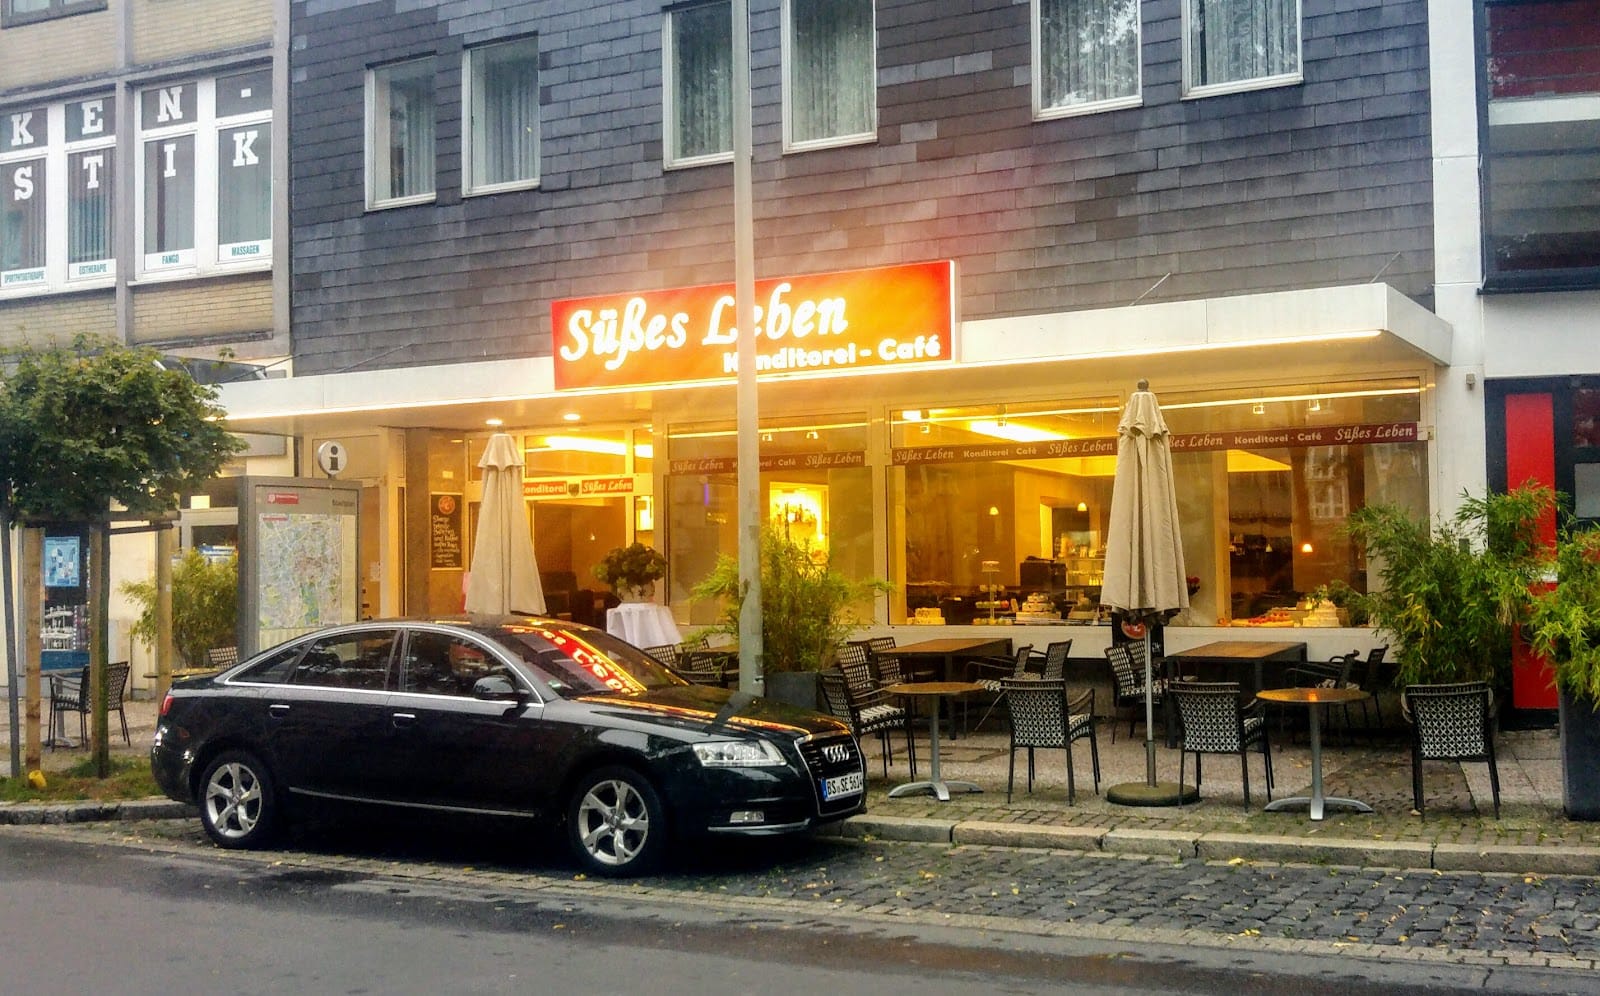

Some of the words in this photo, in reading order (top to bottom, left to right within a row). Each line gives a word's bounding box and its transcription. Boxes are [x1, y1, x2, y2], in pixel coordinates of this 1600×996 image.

[162, 254, 180, 264] FANGO
[231, 245, 260, 256] MASSAGEN
[560, 296, 690, 371] Süßes
[723, 342, 857, 373] Knditorei
[878, 334, 941, 361] Café
[1188, 434, 1223, 447] Leben
[1234, 434, 1289, 445] Konditorei
[1297, 432, 1322, 441] Café
[1335, 426, 1371, 442] Süßes
[1374, 424, 1413, 438] Leben
[805, 453, 831, 468] Süßes
[834, 452, 862, 464] Leben
[895, 448, 922, 464] Süßes
[924, 448, 954, 460] Leben
[963, 448, 1009, 458] Konditorei
[1047, 441, 1078, 456] Süßes
[1081, 440, 1113, 452] Leben
[524, 481, 567, 494] onditorei
[583, 481, 606, 494] Süßes
[608, 479, 633, 490] Leben
[827, 780, 837, 795] BS
[841, 777, 849, 792] SE
